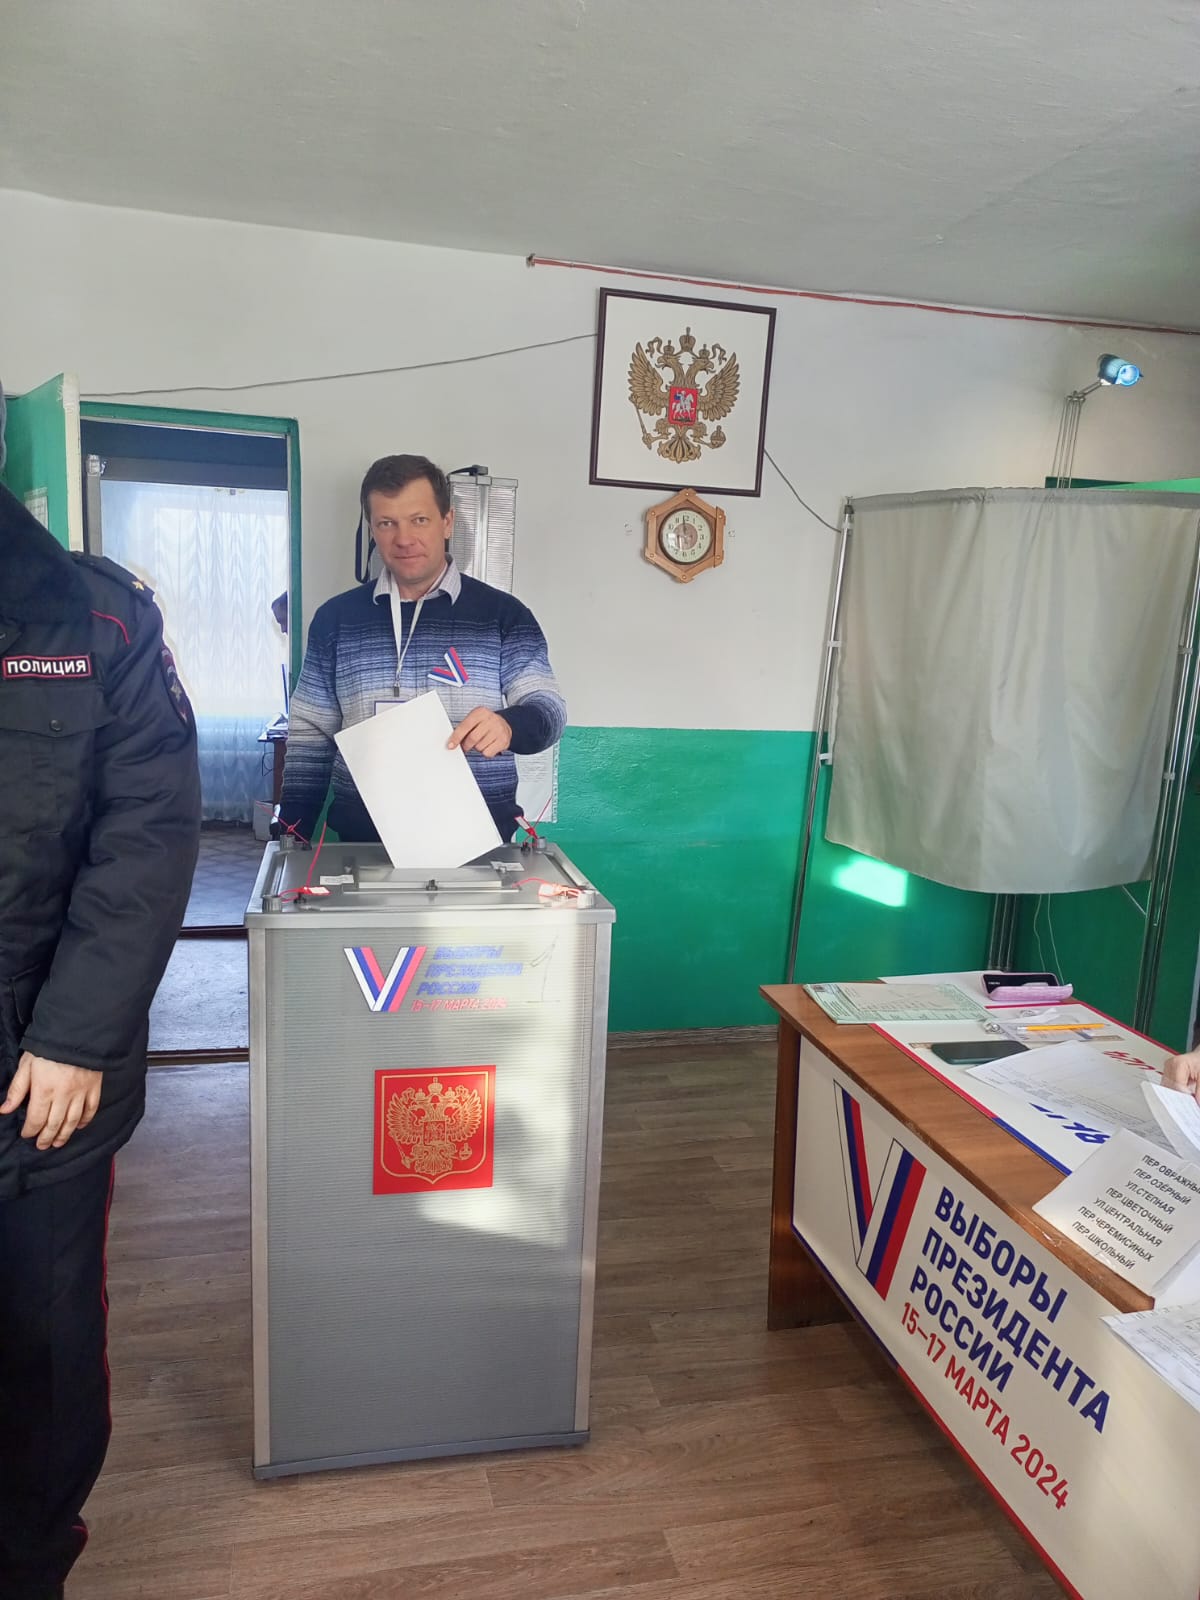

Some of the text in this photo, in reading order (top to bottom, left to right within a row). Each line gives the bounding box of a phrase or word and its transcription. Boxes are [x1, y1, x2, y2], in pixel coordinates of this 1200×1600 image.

[7, 658, 87, 676] ПОЛИЦИЯ
[1141, 1154, 1200, 1195] ПЕР.ОВРАЖНЫ
[935, 1186, 1068, 1324] ВЫБОРЫ
[909, 1269, 1015, 1393] РОССИИ
[921, 1227, 1111, 1434] ПРЕЗИДЕНТА
[944, 1355, 1011, 1446] МАРТА
[1010, 1433, 1069, 1510] 2024
